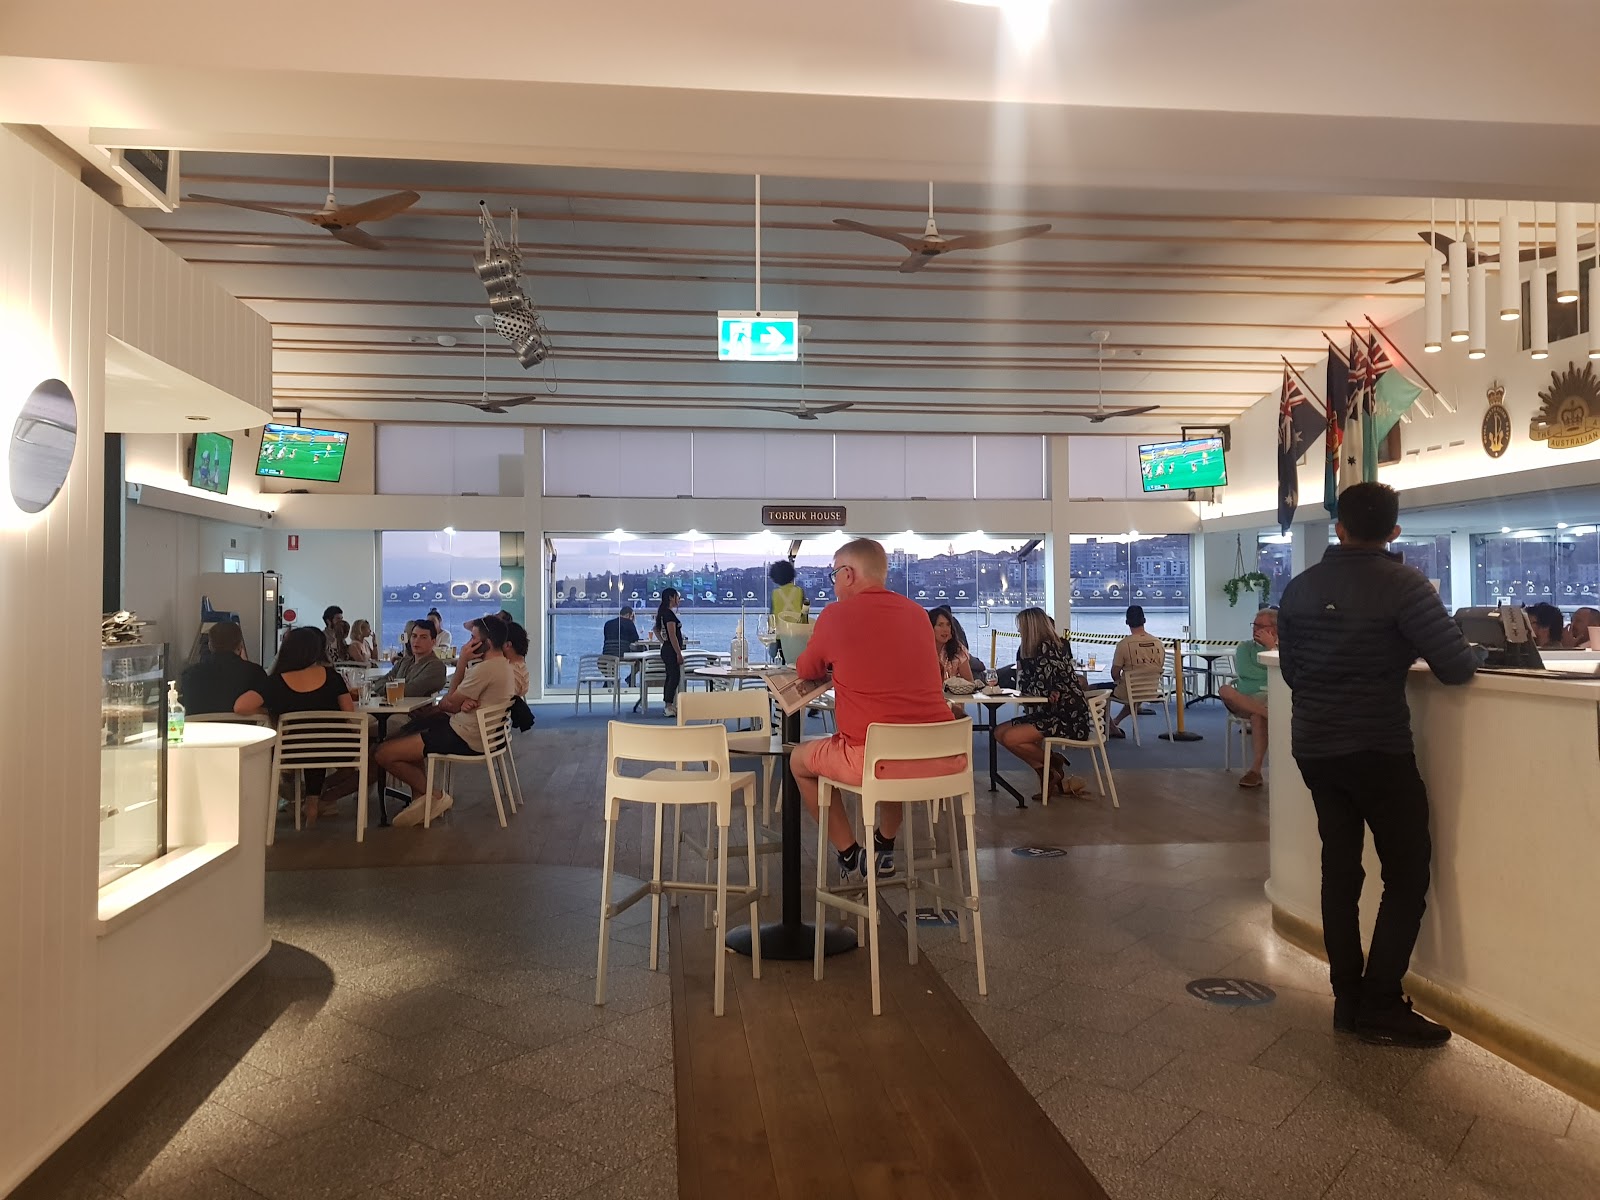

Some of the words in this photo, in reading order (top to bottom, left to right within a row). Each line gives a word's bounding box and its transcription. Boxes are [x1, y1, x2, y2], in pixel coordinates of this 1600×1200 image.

[1537, 430, 1551, 438] THE
[1550, 431, 1598, 446] AUSTRALIAN
[768, 511, 807, 520] TOBRUK
[810, 511, 841, 521] HOUSE
